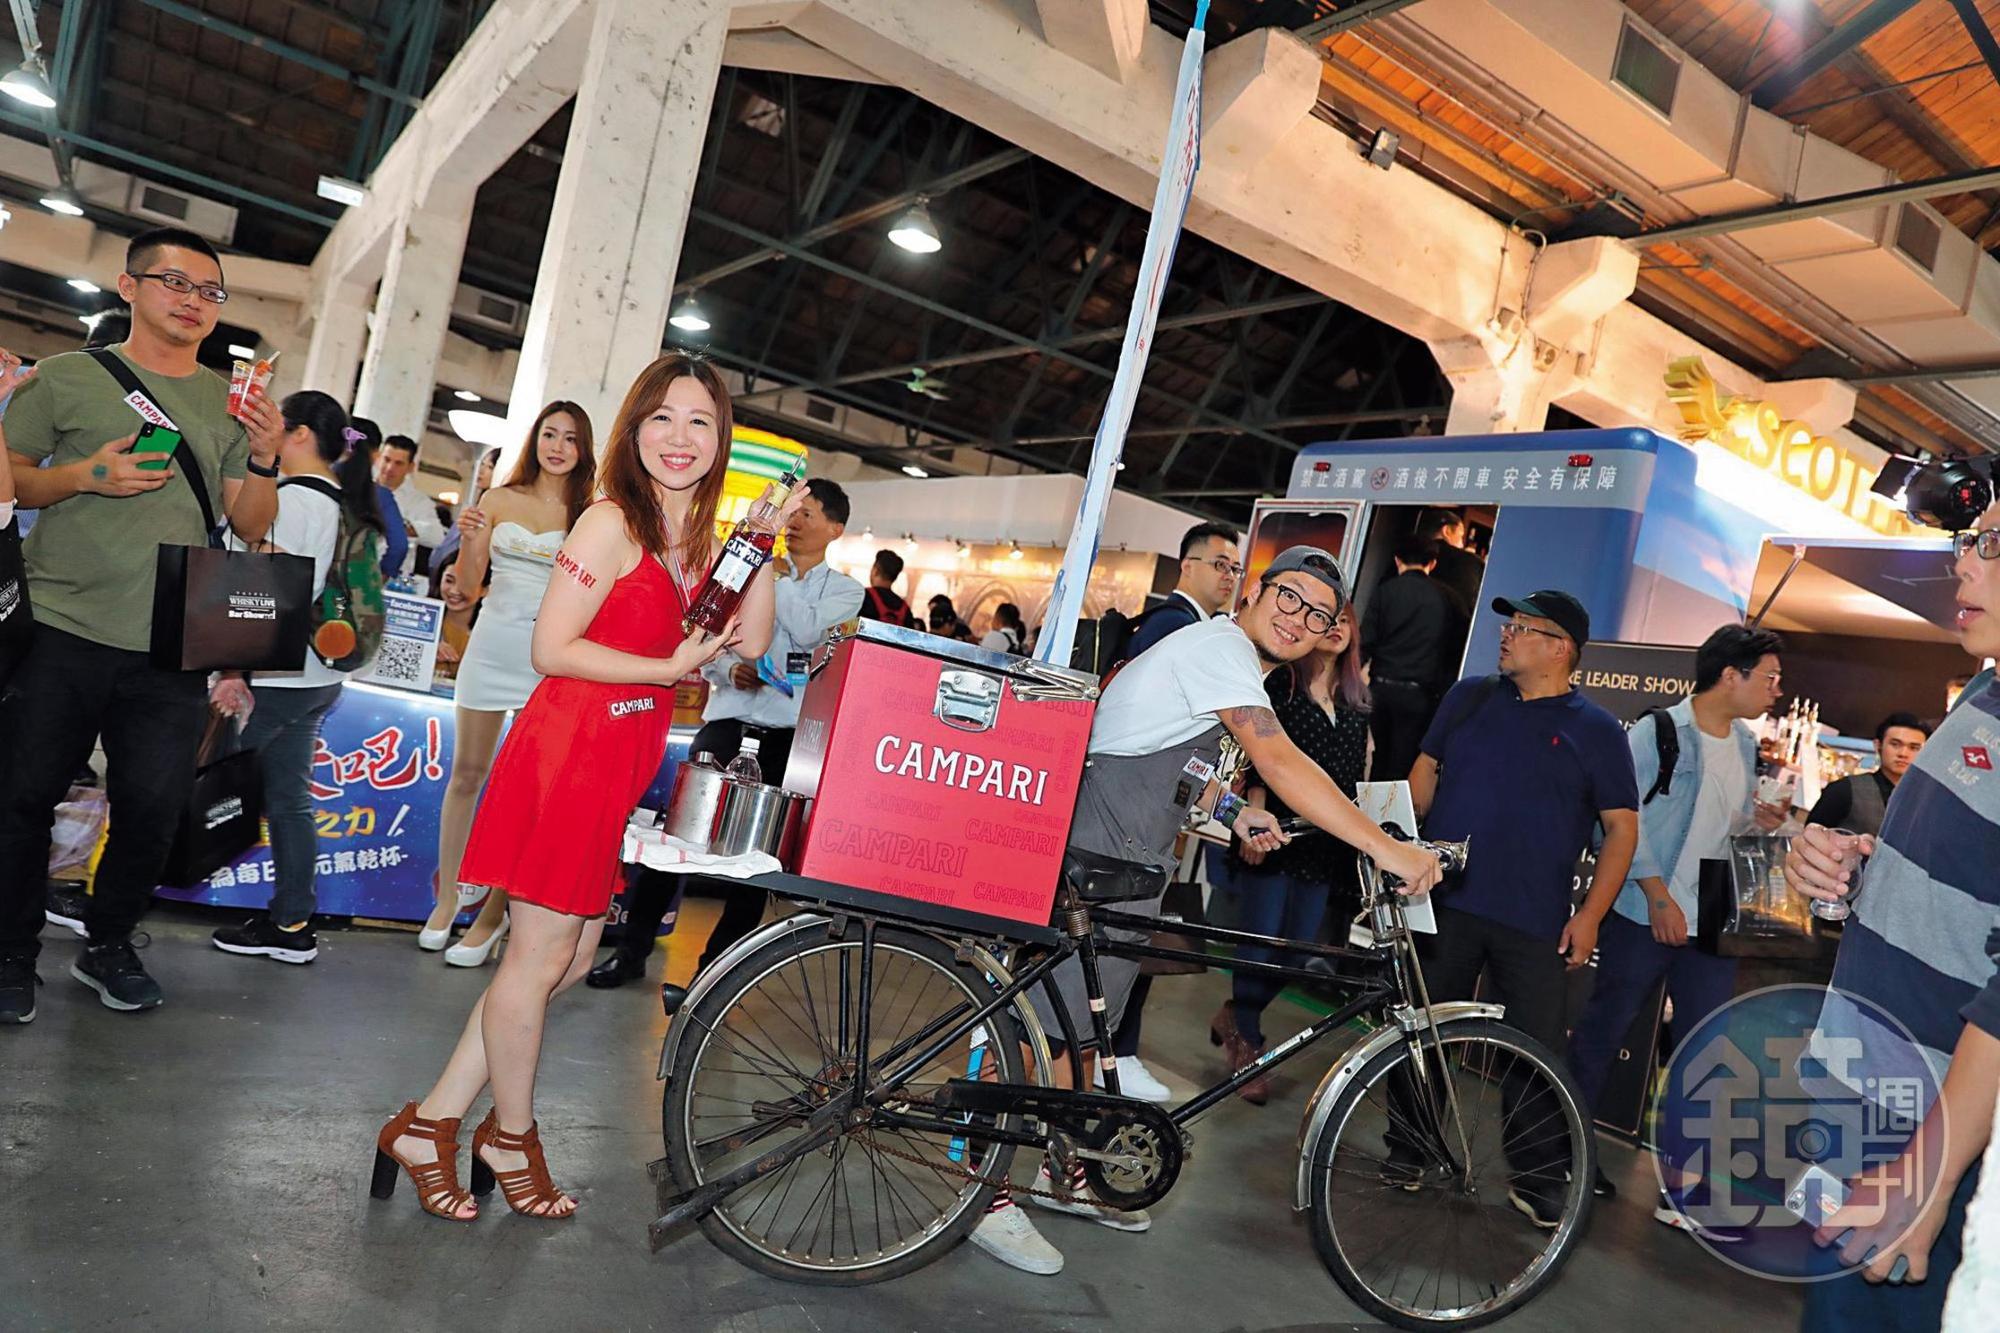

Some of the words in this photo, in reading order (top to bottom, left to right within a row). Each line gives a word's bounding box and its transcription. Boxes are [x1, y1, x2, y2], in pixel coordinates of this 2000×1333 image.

[130, 394, 174, 430] CAMPAR
[1301, 468, 1366, 489] 禁止酒駕
[1393, 467, 1491, 489] 酒後不開車
[1502, 466, 1617, 491] 安全有保障
[725, 538, 763, 567] CAMPARI
[555, 550, 597, 589] CAMPARI
[229, 597, 260, 606] WHISKY
[260, 599, 276, 607] LIVE
[229, 610, 242, 618] Bar
[390, 599, 427, 613] facebook
[1586, 671, 1639, 691] LEADER
[1643, 676, 1697, 696] SHOW
[610, 698, 655, 717] CAMPARI
[874, 734, 1049, 806] CAMPARI
[818, 818, 969, 878] CAMPARI
[964, 817, 1060, 858] CAMPARI
[972, 881, 1047, 911] CAMPARI
